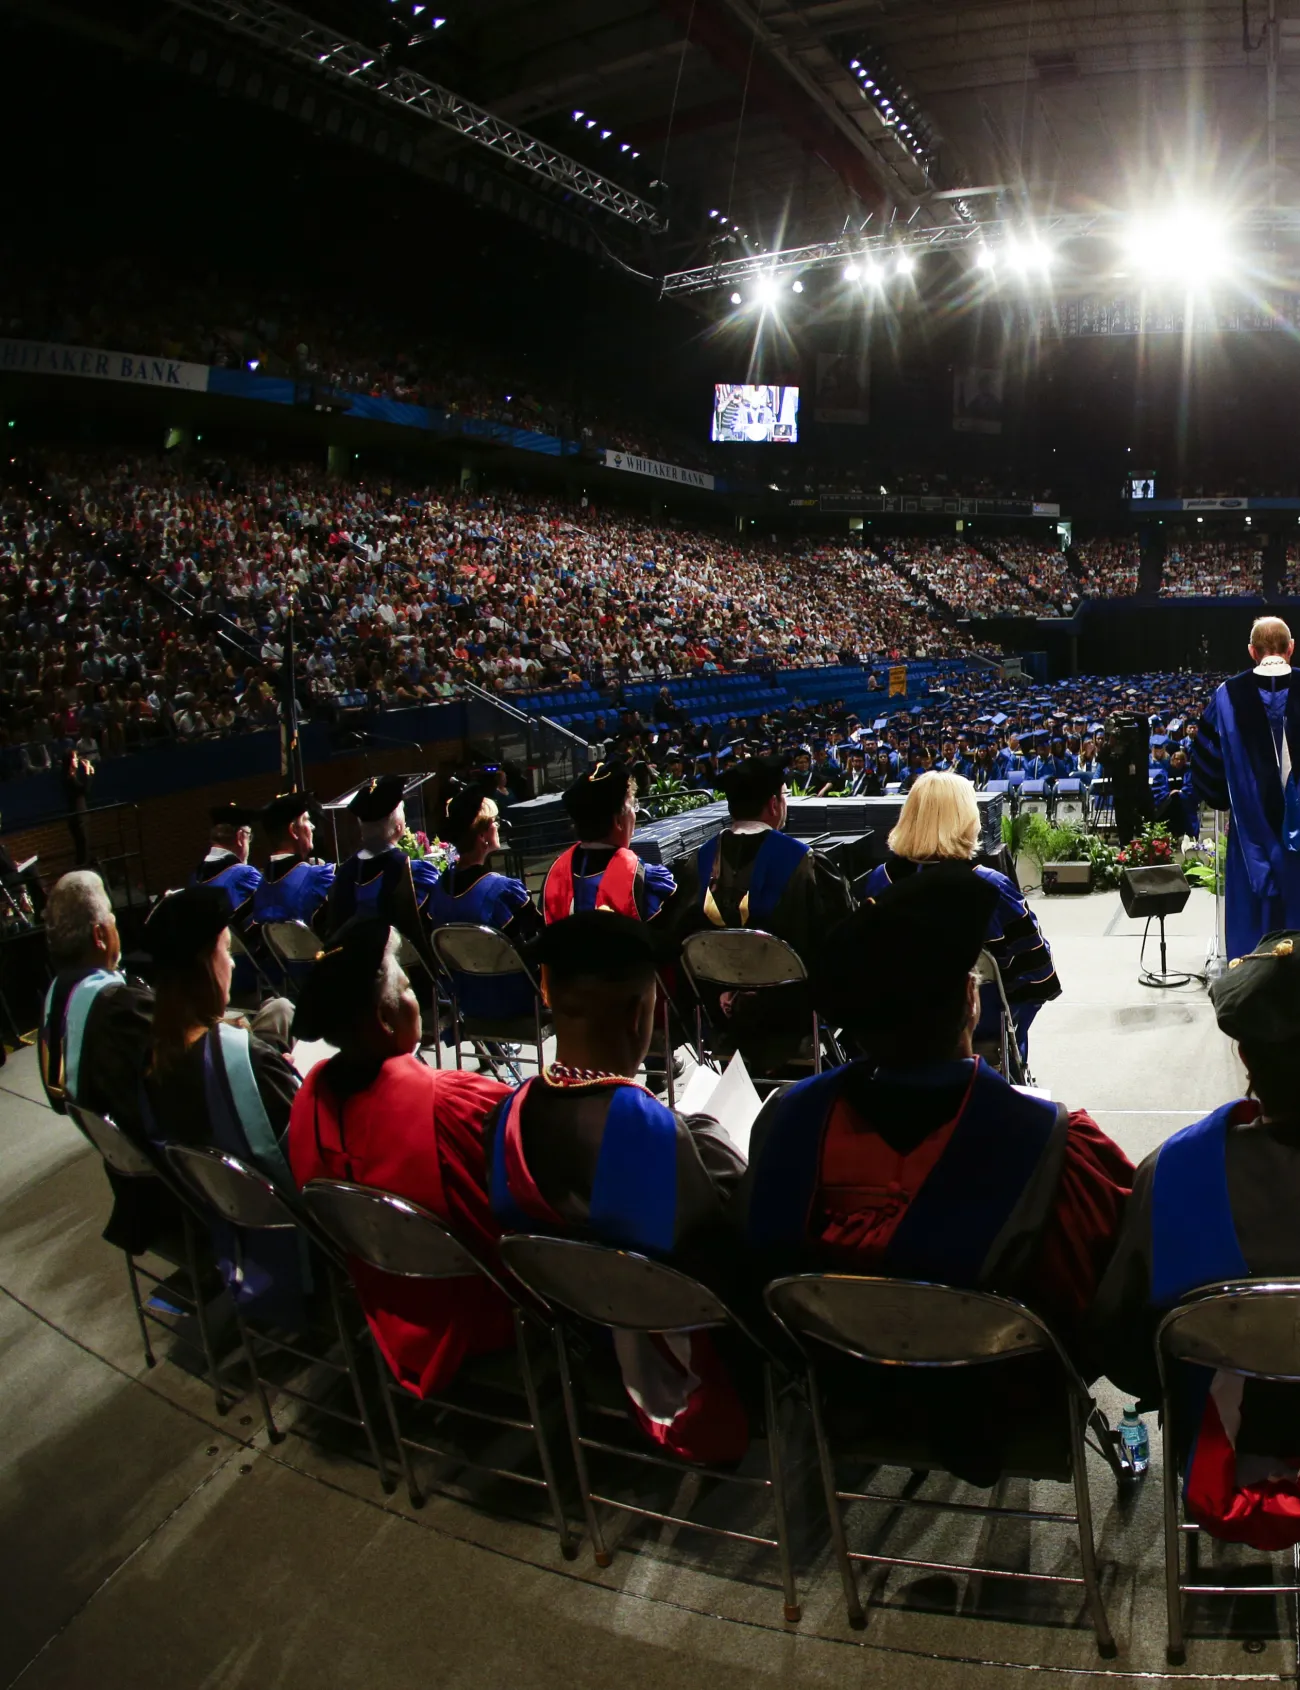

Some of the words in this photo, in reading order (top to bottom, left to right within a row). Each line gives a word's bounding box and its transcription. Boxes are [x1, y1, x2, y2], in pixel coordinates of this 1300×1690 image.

[0, 343, 109, 375] HITAKER
[120, 356, 182, 384] BANK
[626, 457, 678, 480] WHITAKER
[681, 470, 705, 486] BANK
